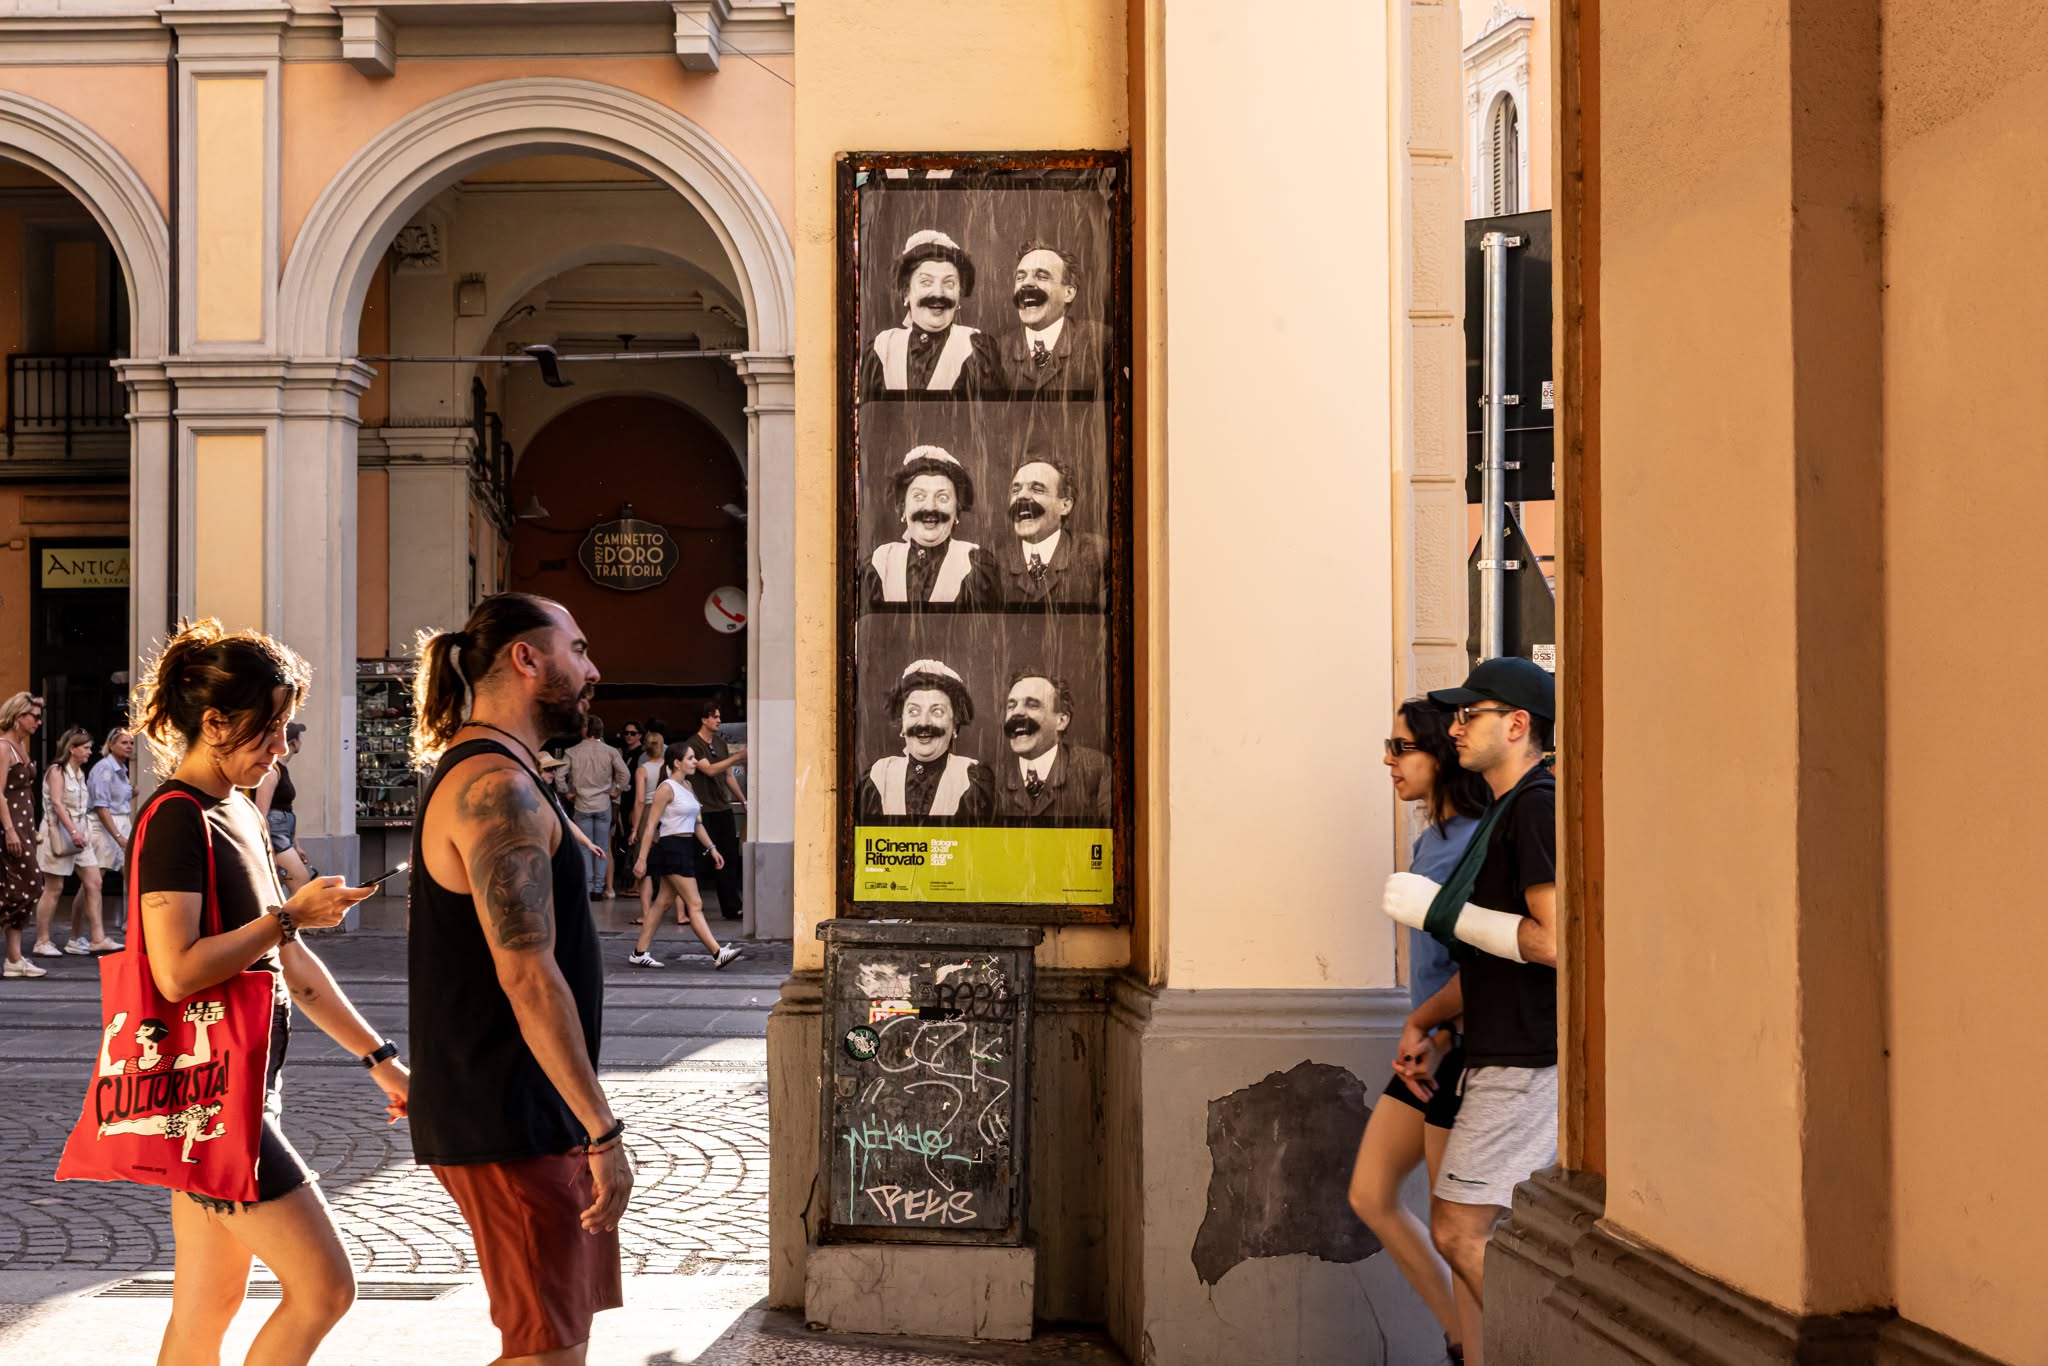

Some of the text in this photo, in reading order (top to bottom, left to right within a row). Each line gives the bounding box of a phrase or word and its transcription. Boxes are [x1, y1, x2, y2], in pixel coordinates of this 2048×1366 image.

[594, 533, 664, 545] CAMINETTO
[594, 546, 603, 563] 1927
[604, 545, 664, 564] D'ORO
[595, 565, 663, 577] TRATTORIA
[865, 838, 928, 853] Il Cinema
[930, 839, 958, 848] Bologna
[865, 852, 925, 866] Ritrovato
[95, 1050, 230, 1126] CULTURISTA!
